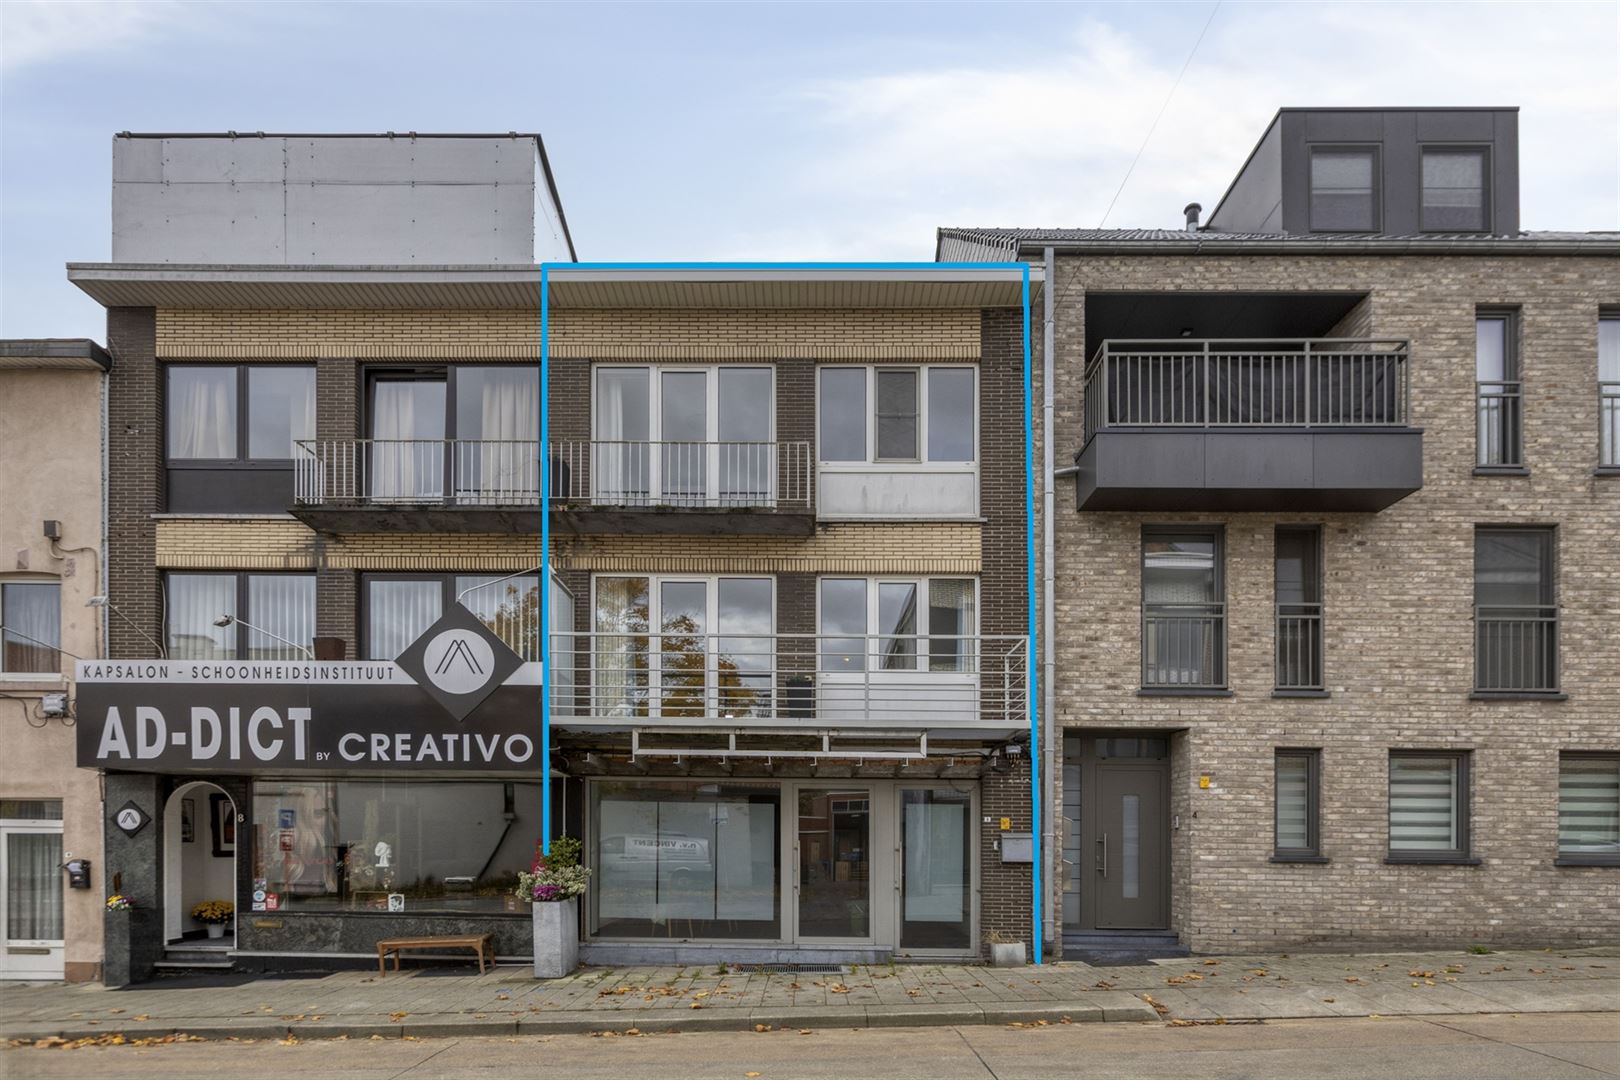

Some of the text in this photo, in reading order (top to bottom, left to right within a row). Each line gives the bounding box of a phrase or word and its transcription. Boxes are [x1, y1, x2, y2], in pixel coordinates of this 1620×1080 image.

[84, 665, 168, 679] KAPSALON
[191, 665, 394, 680] SCHOONHEIDSINSTITUUT
[96, 705, 534, 763] AD-DICT BY CREATIVO
[237, 813, 245, 823] 8
